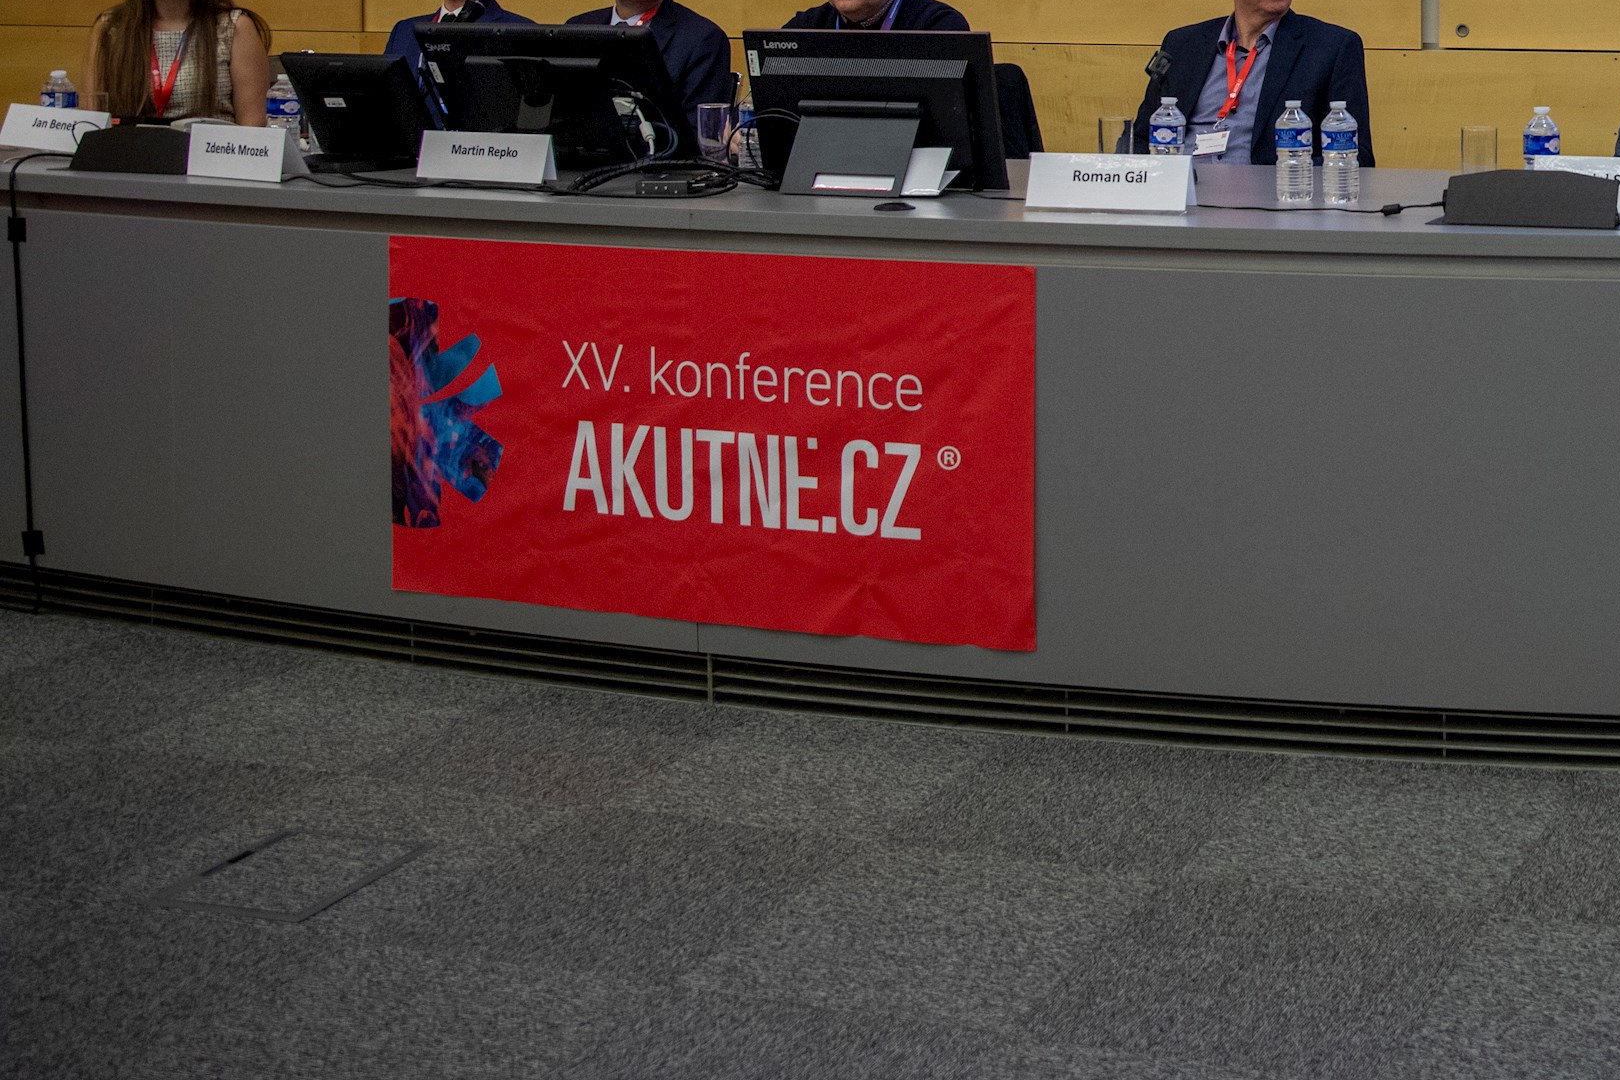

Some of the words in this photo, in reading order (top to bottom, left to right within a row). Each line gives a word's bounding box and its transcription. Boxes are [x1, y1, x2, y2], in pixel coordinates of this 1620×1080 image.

[763, 39, 799, 49] Lenovo
[32, 117, 48, 129] Jan
[205, 141, 237, 156] Zdeněk
[237, 144, 269, 158] Mrozek
[451, 144, 486, 157] Martin
[487, 146, 518, 160] Repko
[1072, 169, 1121, 184] Roman
[1125, 170, 1148, 184] Gál
[562, 340, 630, 394] XV.
[650, 346, 923, 412] konference
